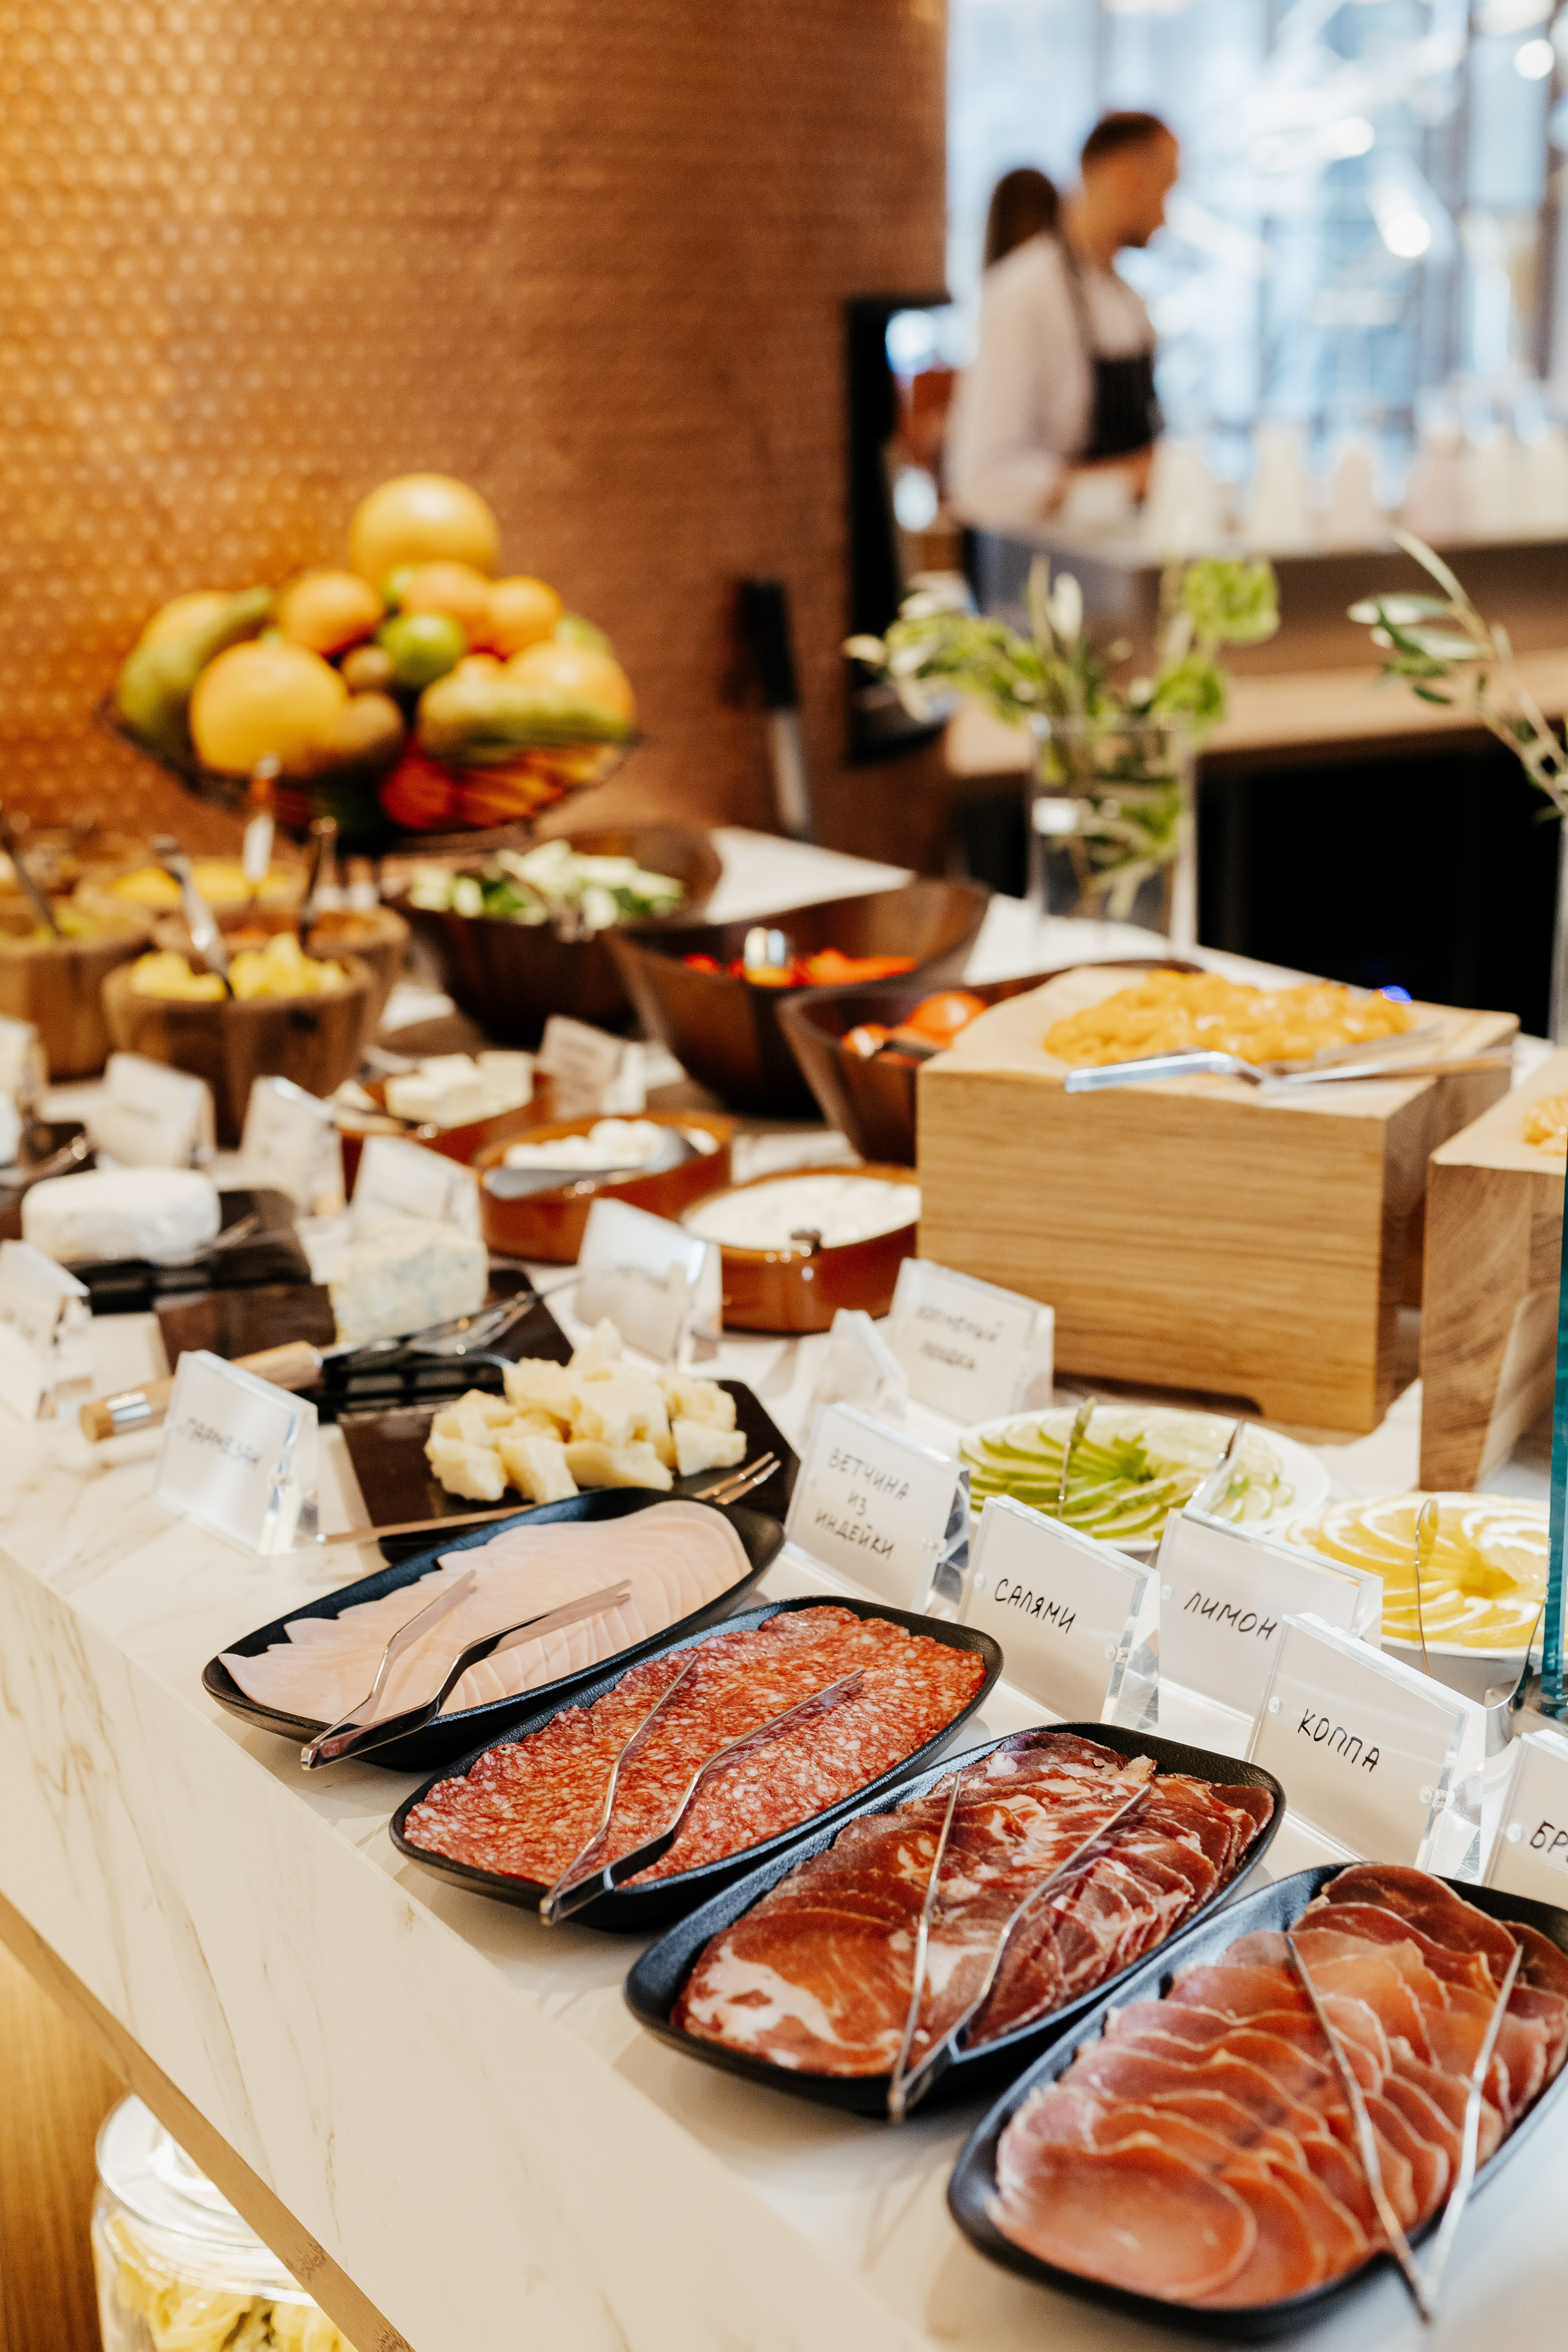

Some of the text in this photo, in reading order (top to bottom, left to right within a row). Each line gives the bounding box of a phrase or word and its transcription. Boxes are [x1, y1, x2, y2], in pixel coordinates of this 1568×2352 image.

[829, 1447, 910, 1500] ВЕТЧИНА
[847, 1490, 867, 1516] ИЗ
[815, 1509, 895, 1560] ИНДЕЙКИ
[994, 1578, 1076, 1634] САЛЯМИ
[1183, 1591, 1278, 1641] ЛИМОН
[1297, 1708, 1380, 1773] КОППА
[1529, 1820, 1568, 1863] БР
